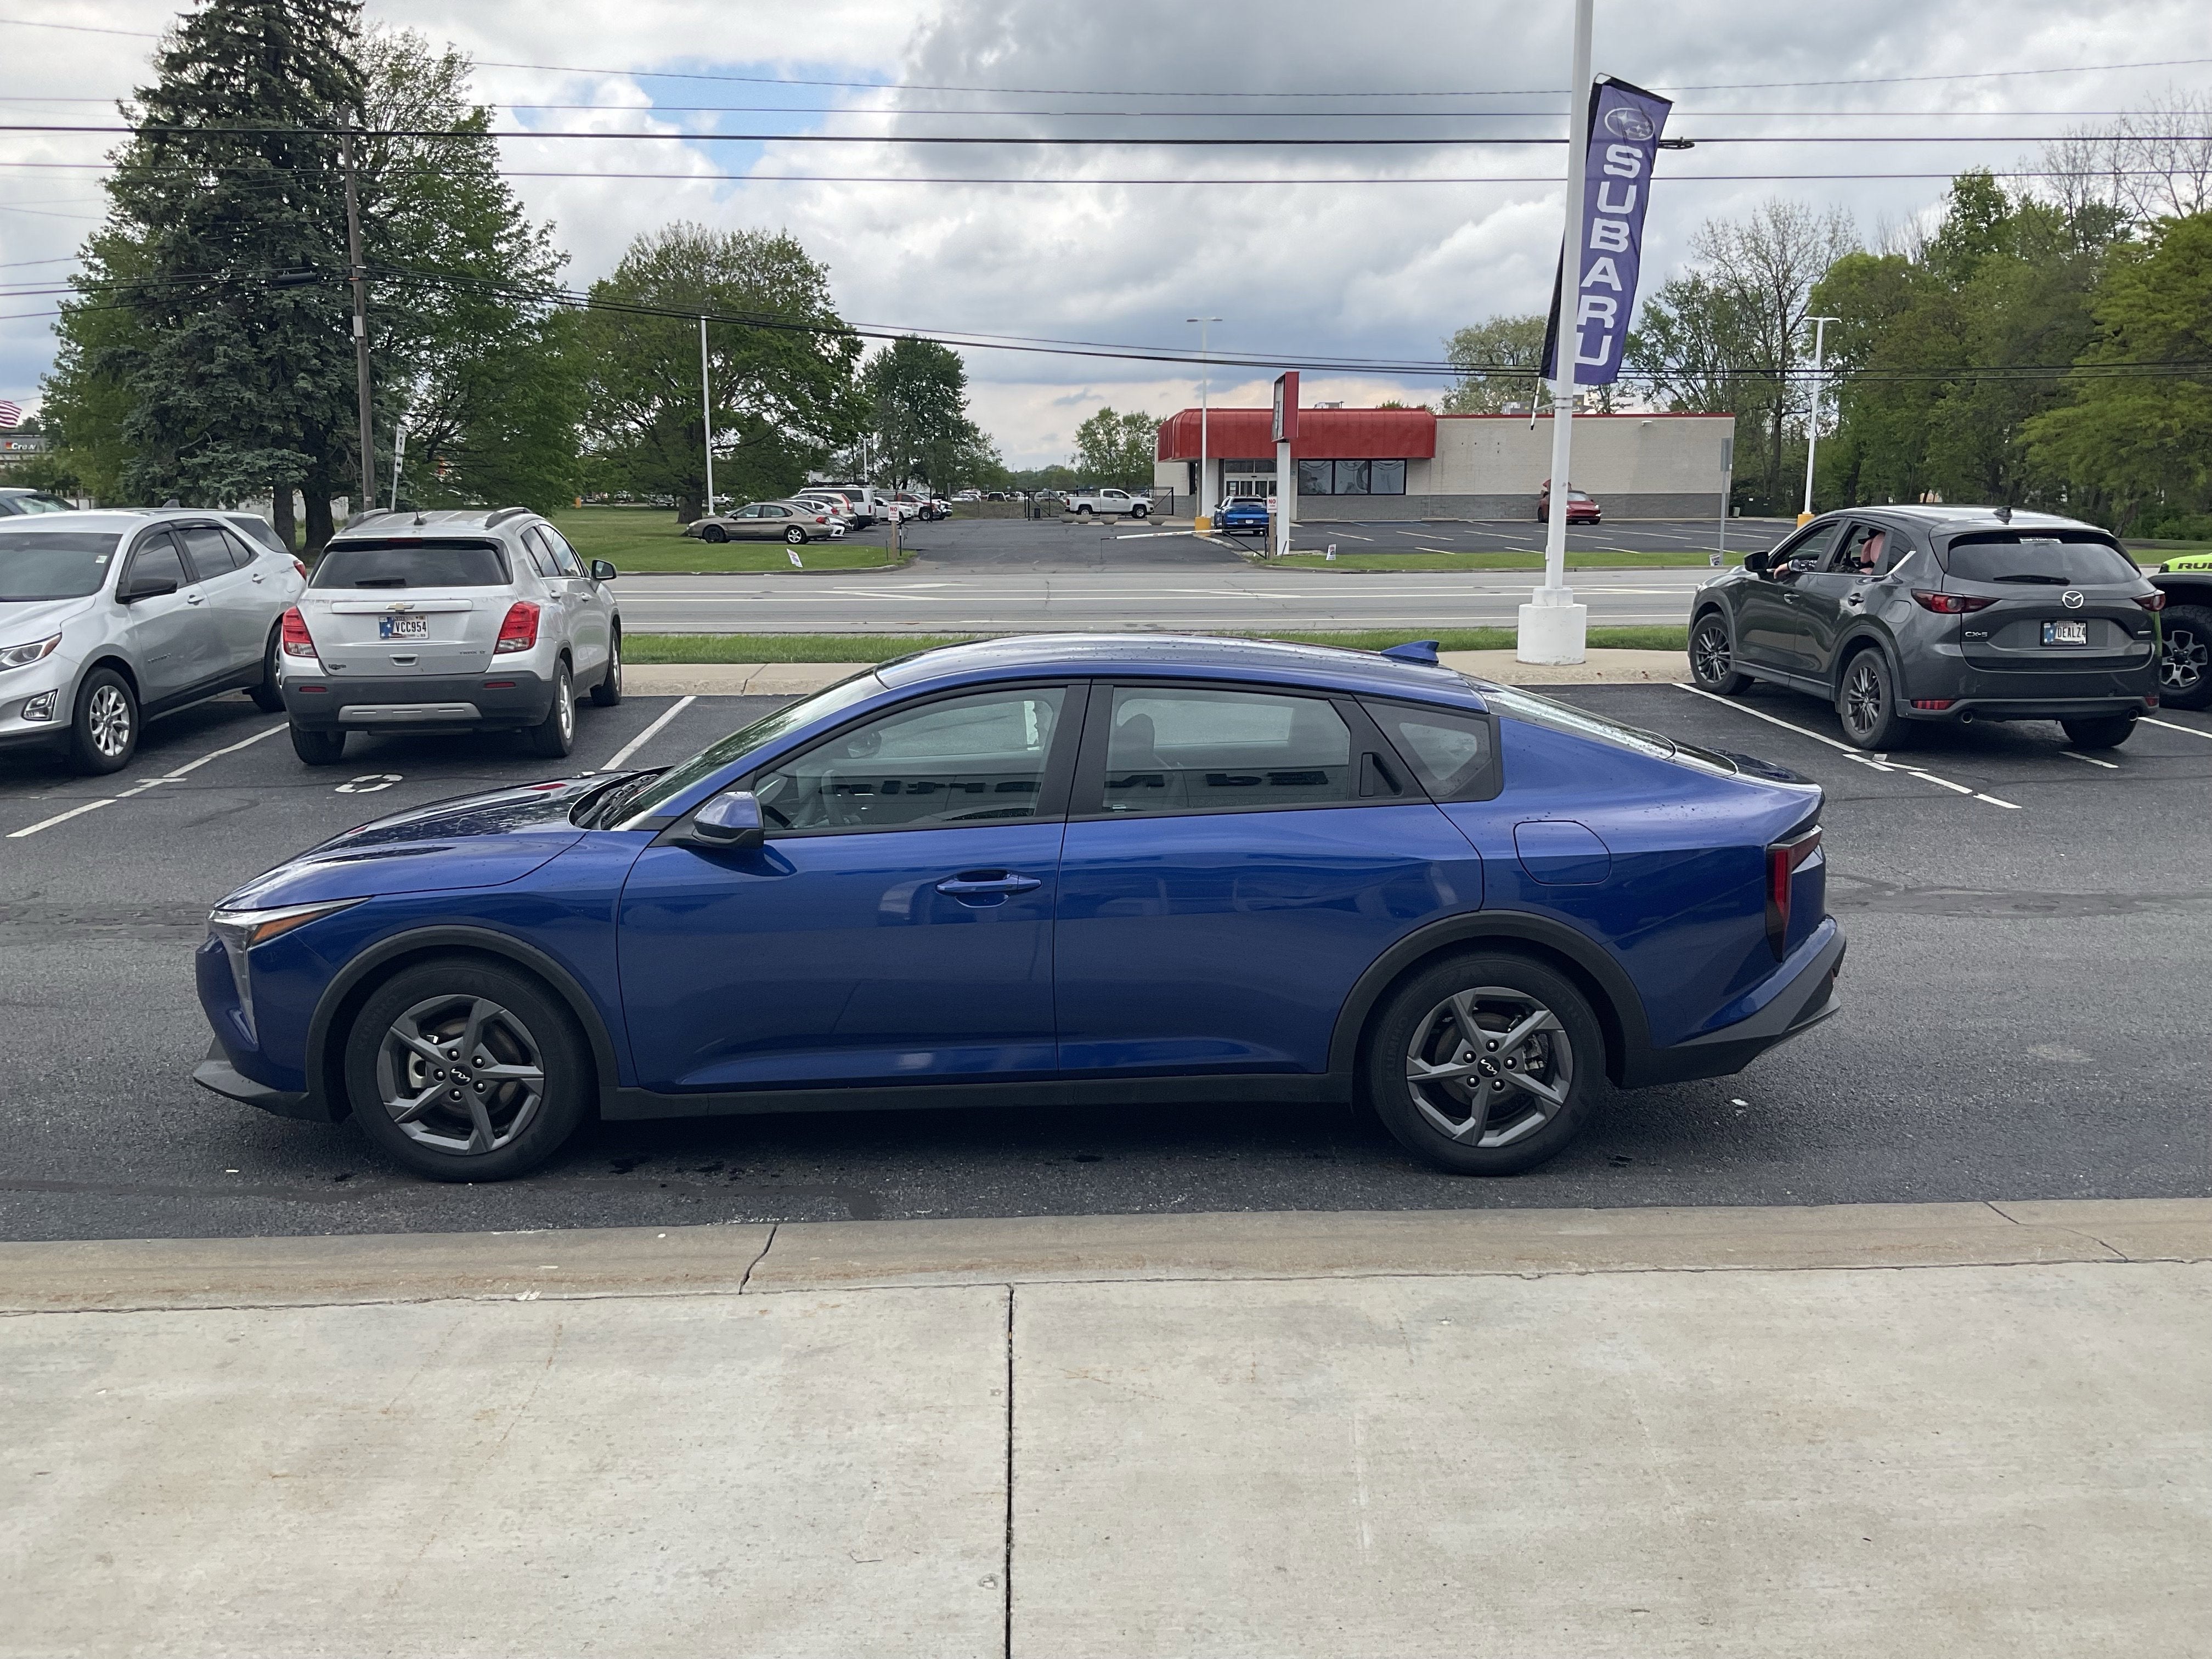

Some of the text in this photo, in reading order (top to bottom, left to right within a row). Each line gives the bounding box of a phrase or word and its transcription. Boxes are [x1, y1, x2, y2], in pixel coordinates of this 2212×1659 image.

[1575, 144, 1643, 366] SUBARU
[399, 437, 403, 450] 9
[395, 621, 427, 633] VCC954
